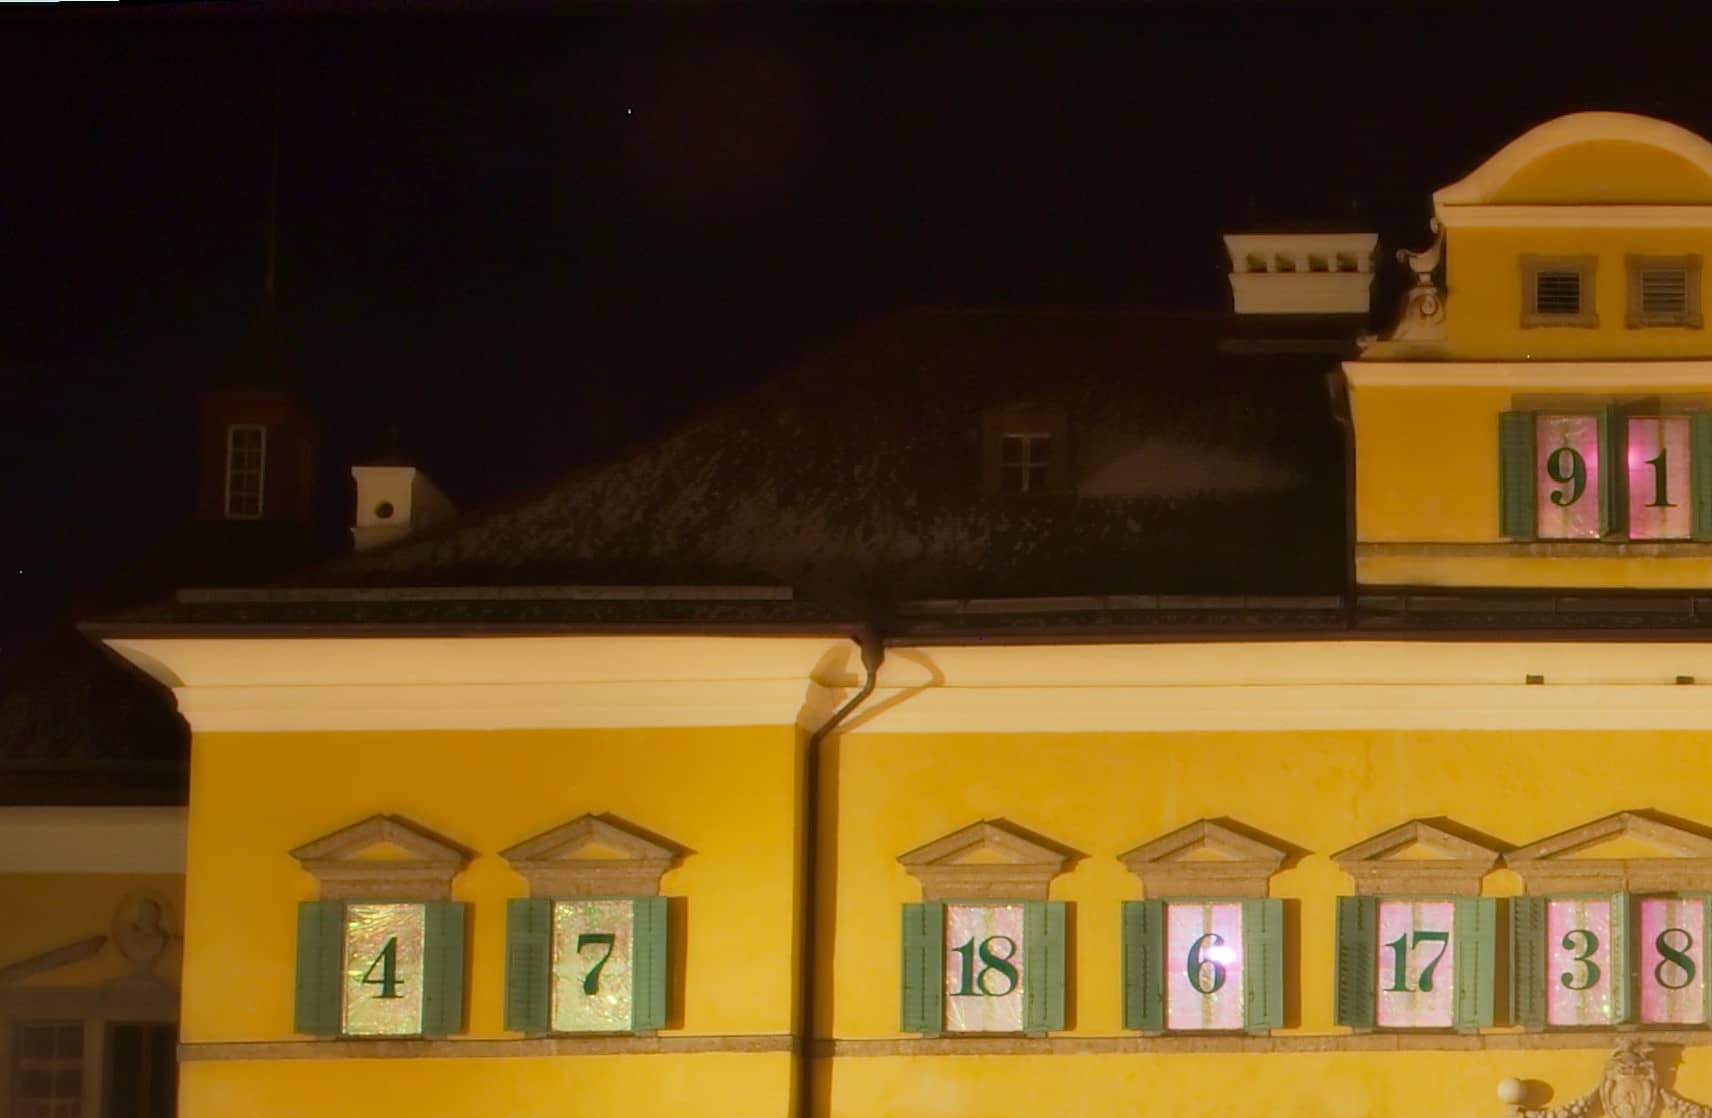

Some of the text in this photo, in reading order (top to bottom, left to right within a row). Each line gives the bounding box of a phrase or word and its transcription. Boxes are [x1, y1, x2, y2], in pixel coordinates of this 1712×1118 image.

[1547, 447, 1587, 507] 9
[1645, 448, 1678, 507] 1
[362, 937, 404, 999] 4
[577, 933, 615, 995] 7
[950, 935, 1020, 997] 18
[1187, 932, 1227, 994] 6
[1383, 930, 1450, 993] 17
[1561, 928, 1601, 990] 3
[1655, 928, 1696, 990] 8
